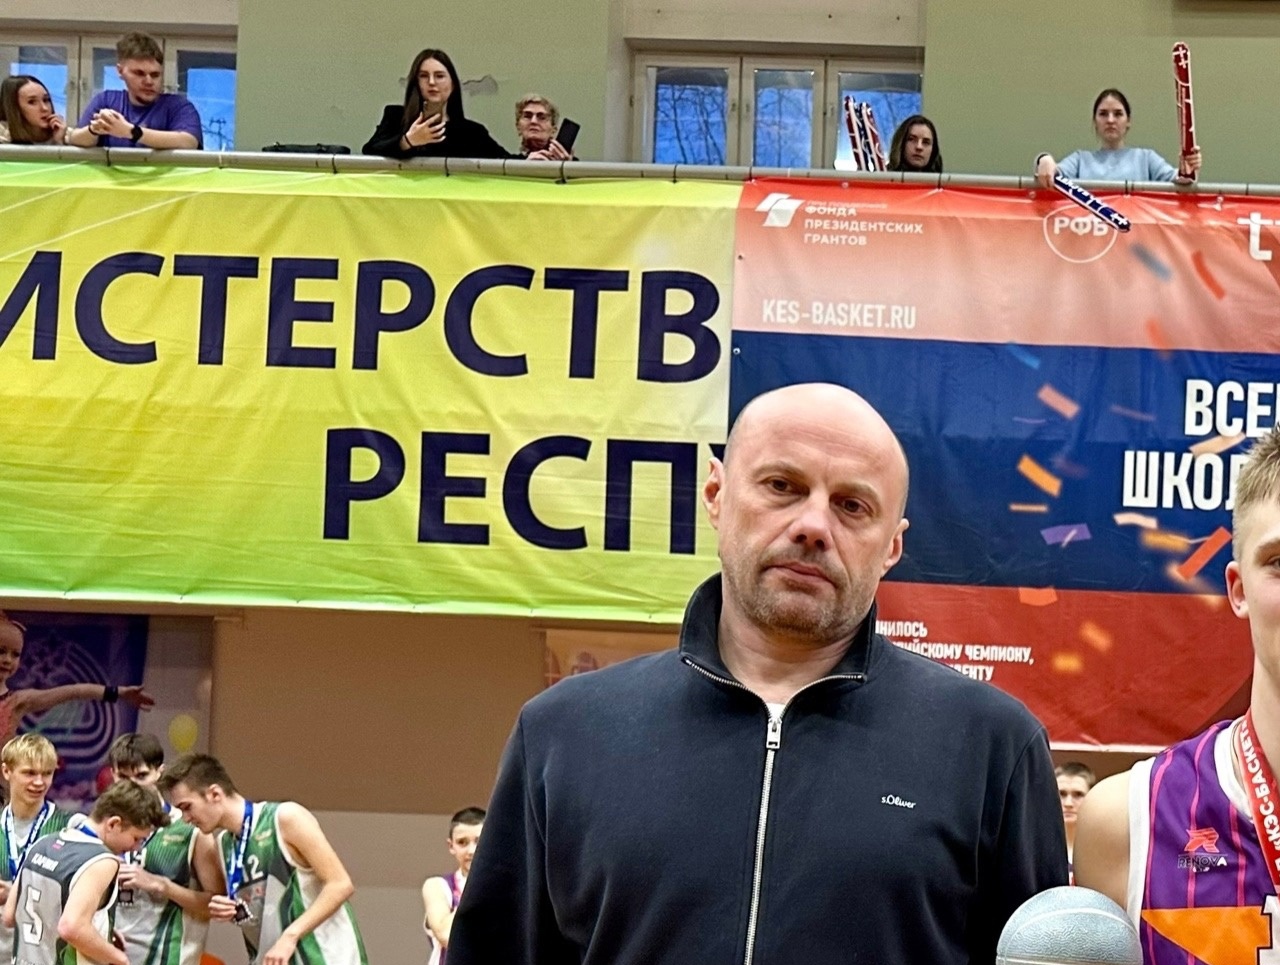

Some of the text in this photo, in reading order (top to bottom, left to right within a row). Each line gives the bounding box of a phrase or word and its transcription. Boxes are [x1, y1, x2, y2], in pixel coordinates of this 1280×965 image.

[805, 206, 857, 216] ФОНДА
[804, 218, 923, 234] ПРЕЗИДЕНТСКИХ
[804, 233, 867, 246] ГРАНТОВ
[762, 299, 916, 329] KES-BASKET.RU
[322, 428, 726, 554] РЕСП
[964, 643, 1035, 666] ЧЕМПИОНУ,
[881, 794, 916, 809] s.Oliver
[22, 884, 43, 945] 5
